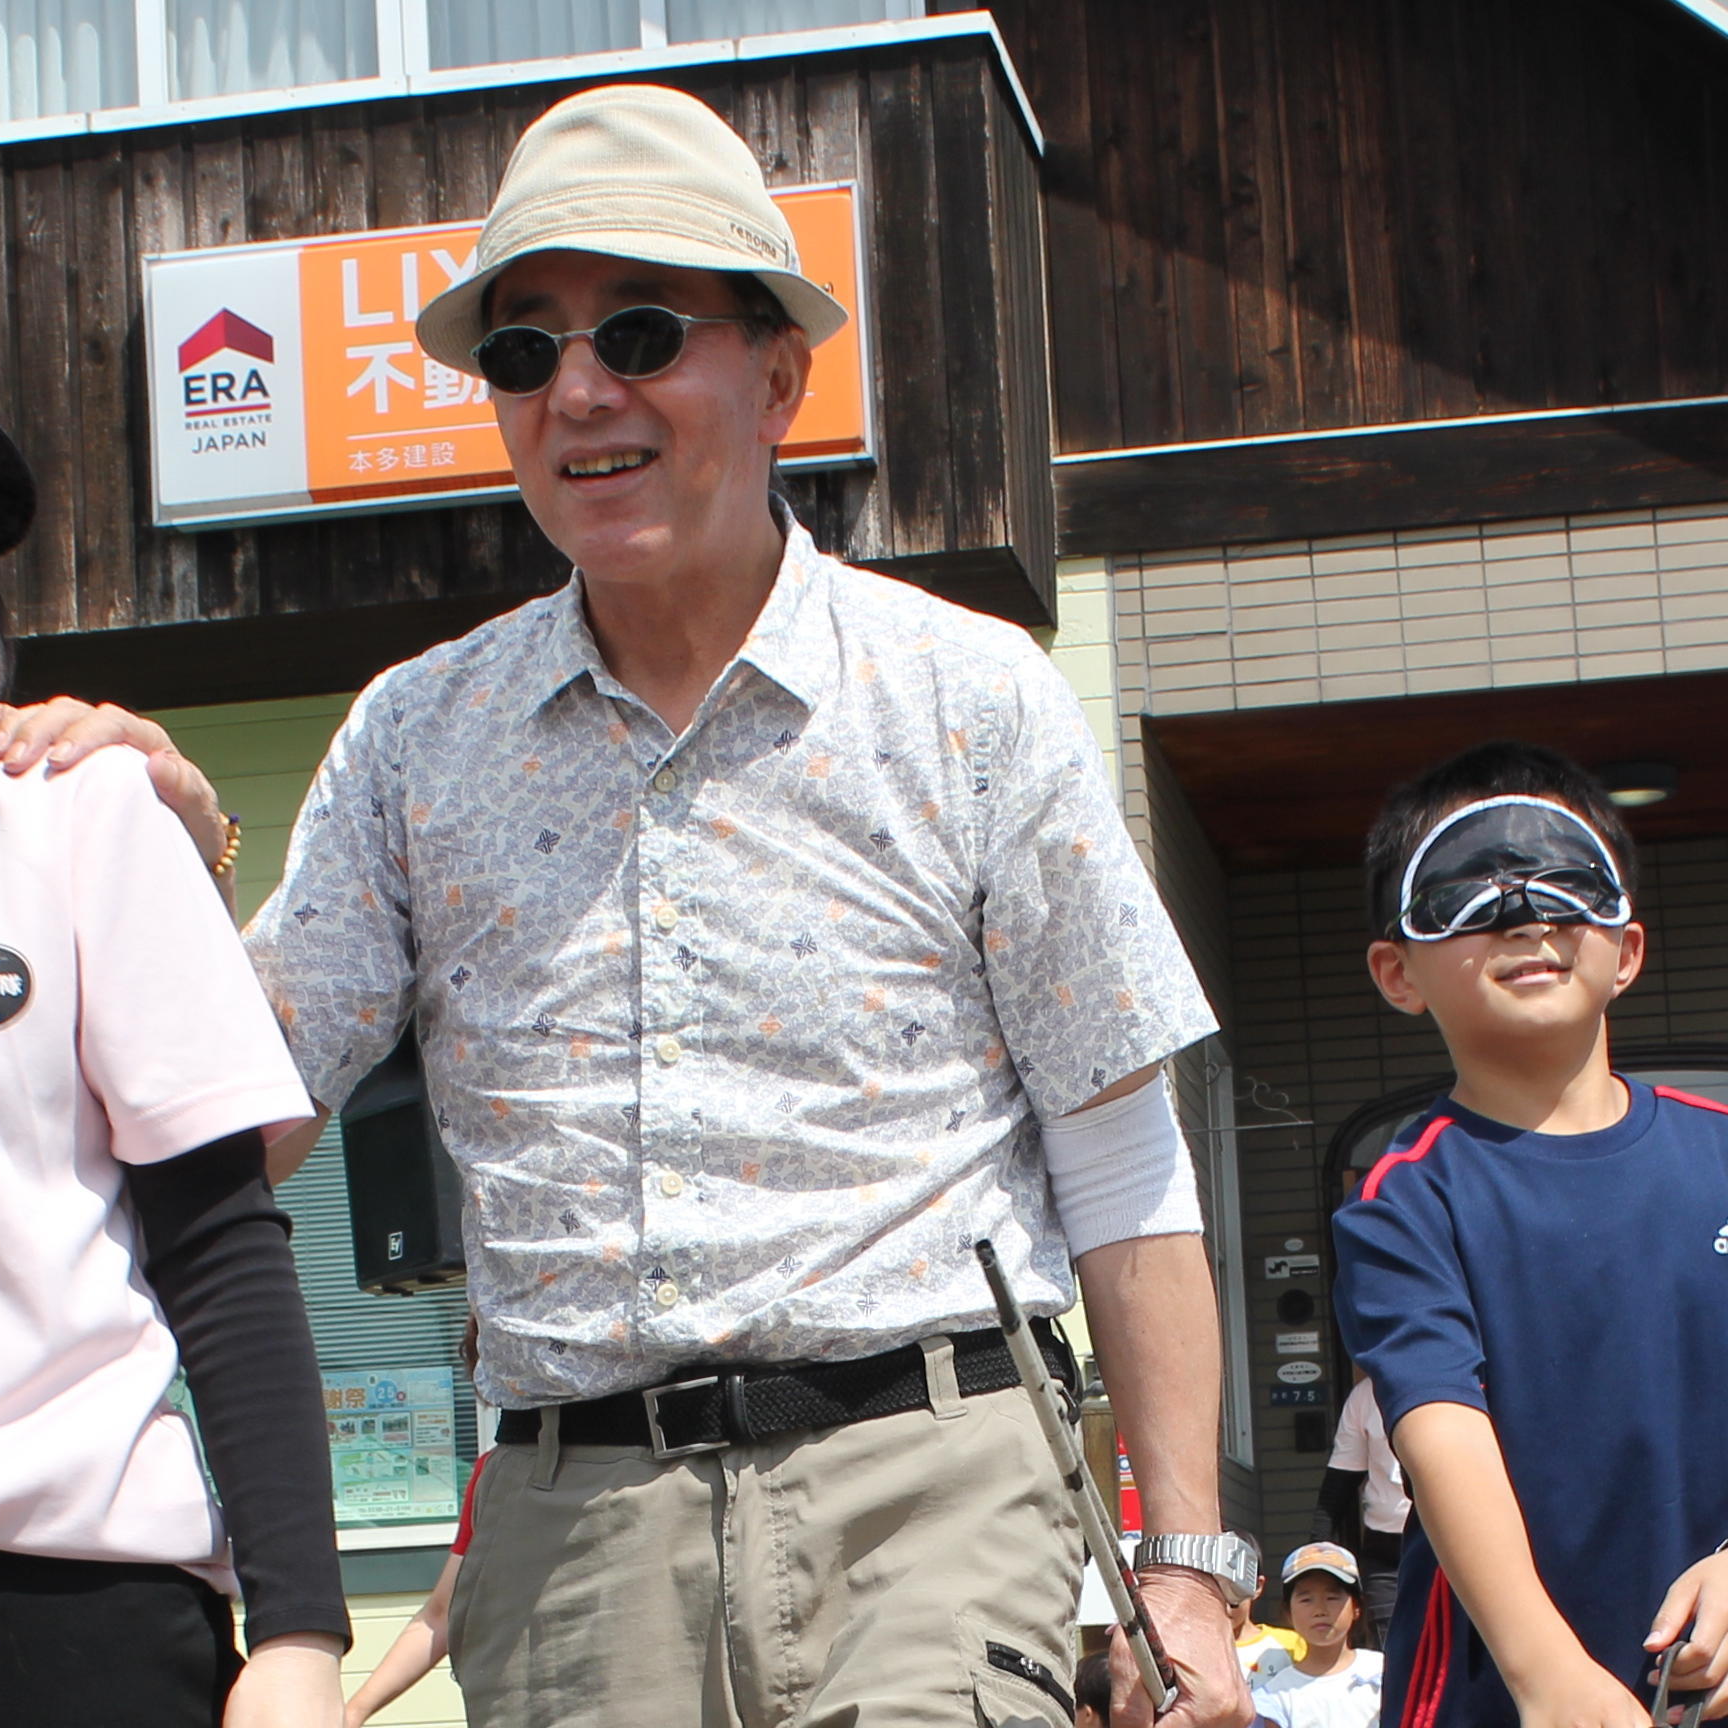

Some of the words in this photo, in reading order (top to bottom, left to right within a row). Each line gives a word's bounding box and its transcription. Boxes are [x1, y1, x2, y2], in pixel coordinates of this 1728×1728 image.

[729, 222, 778, 259] renoma
[183, 367, 270, 406] ERA
[184, 420, 218, 431] REAL
[223, 413, 272, 427] ESTATE
[191, 431, 266, 454] JAPAN
[348, 441, 457, 473] 本多建設
